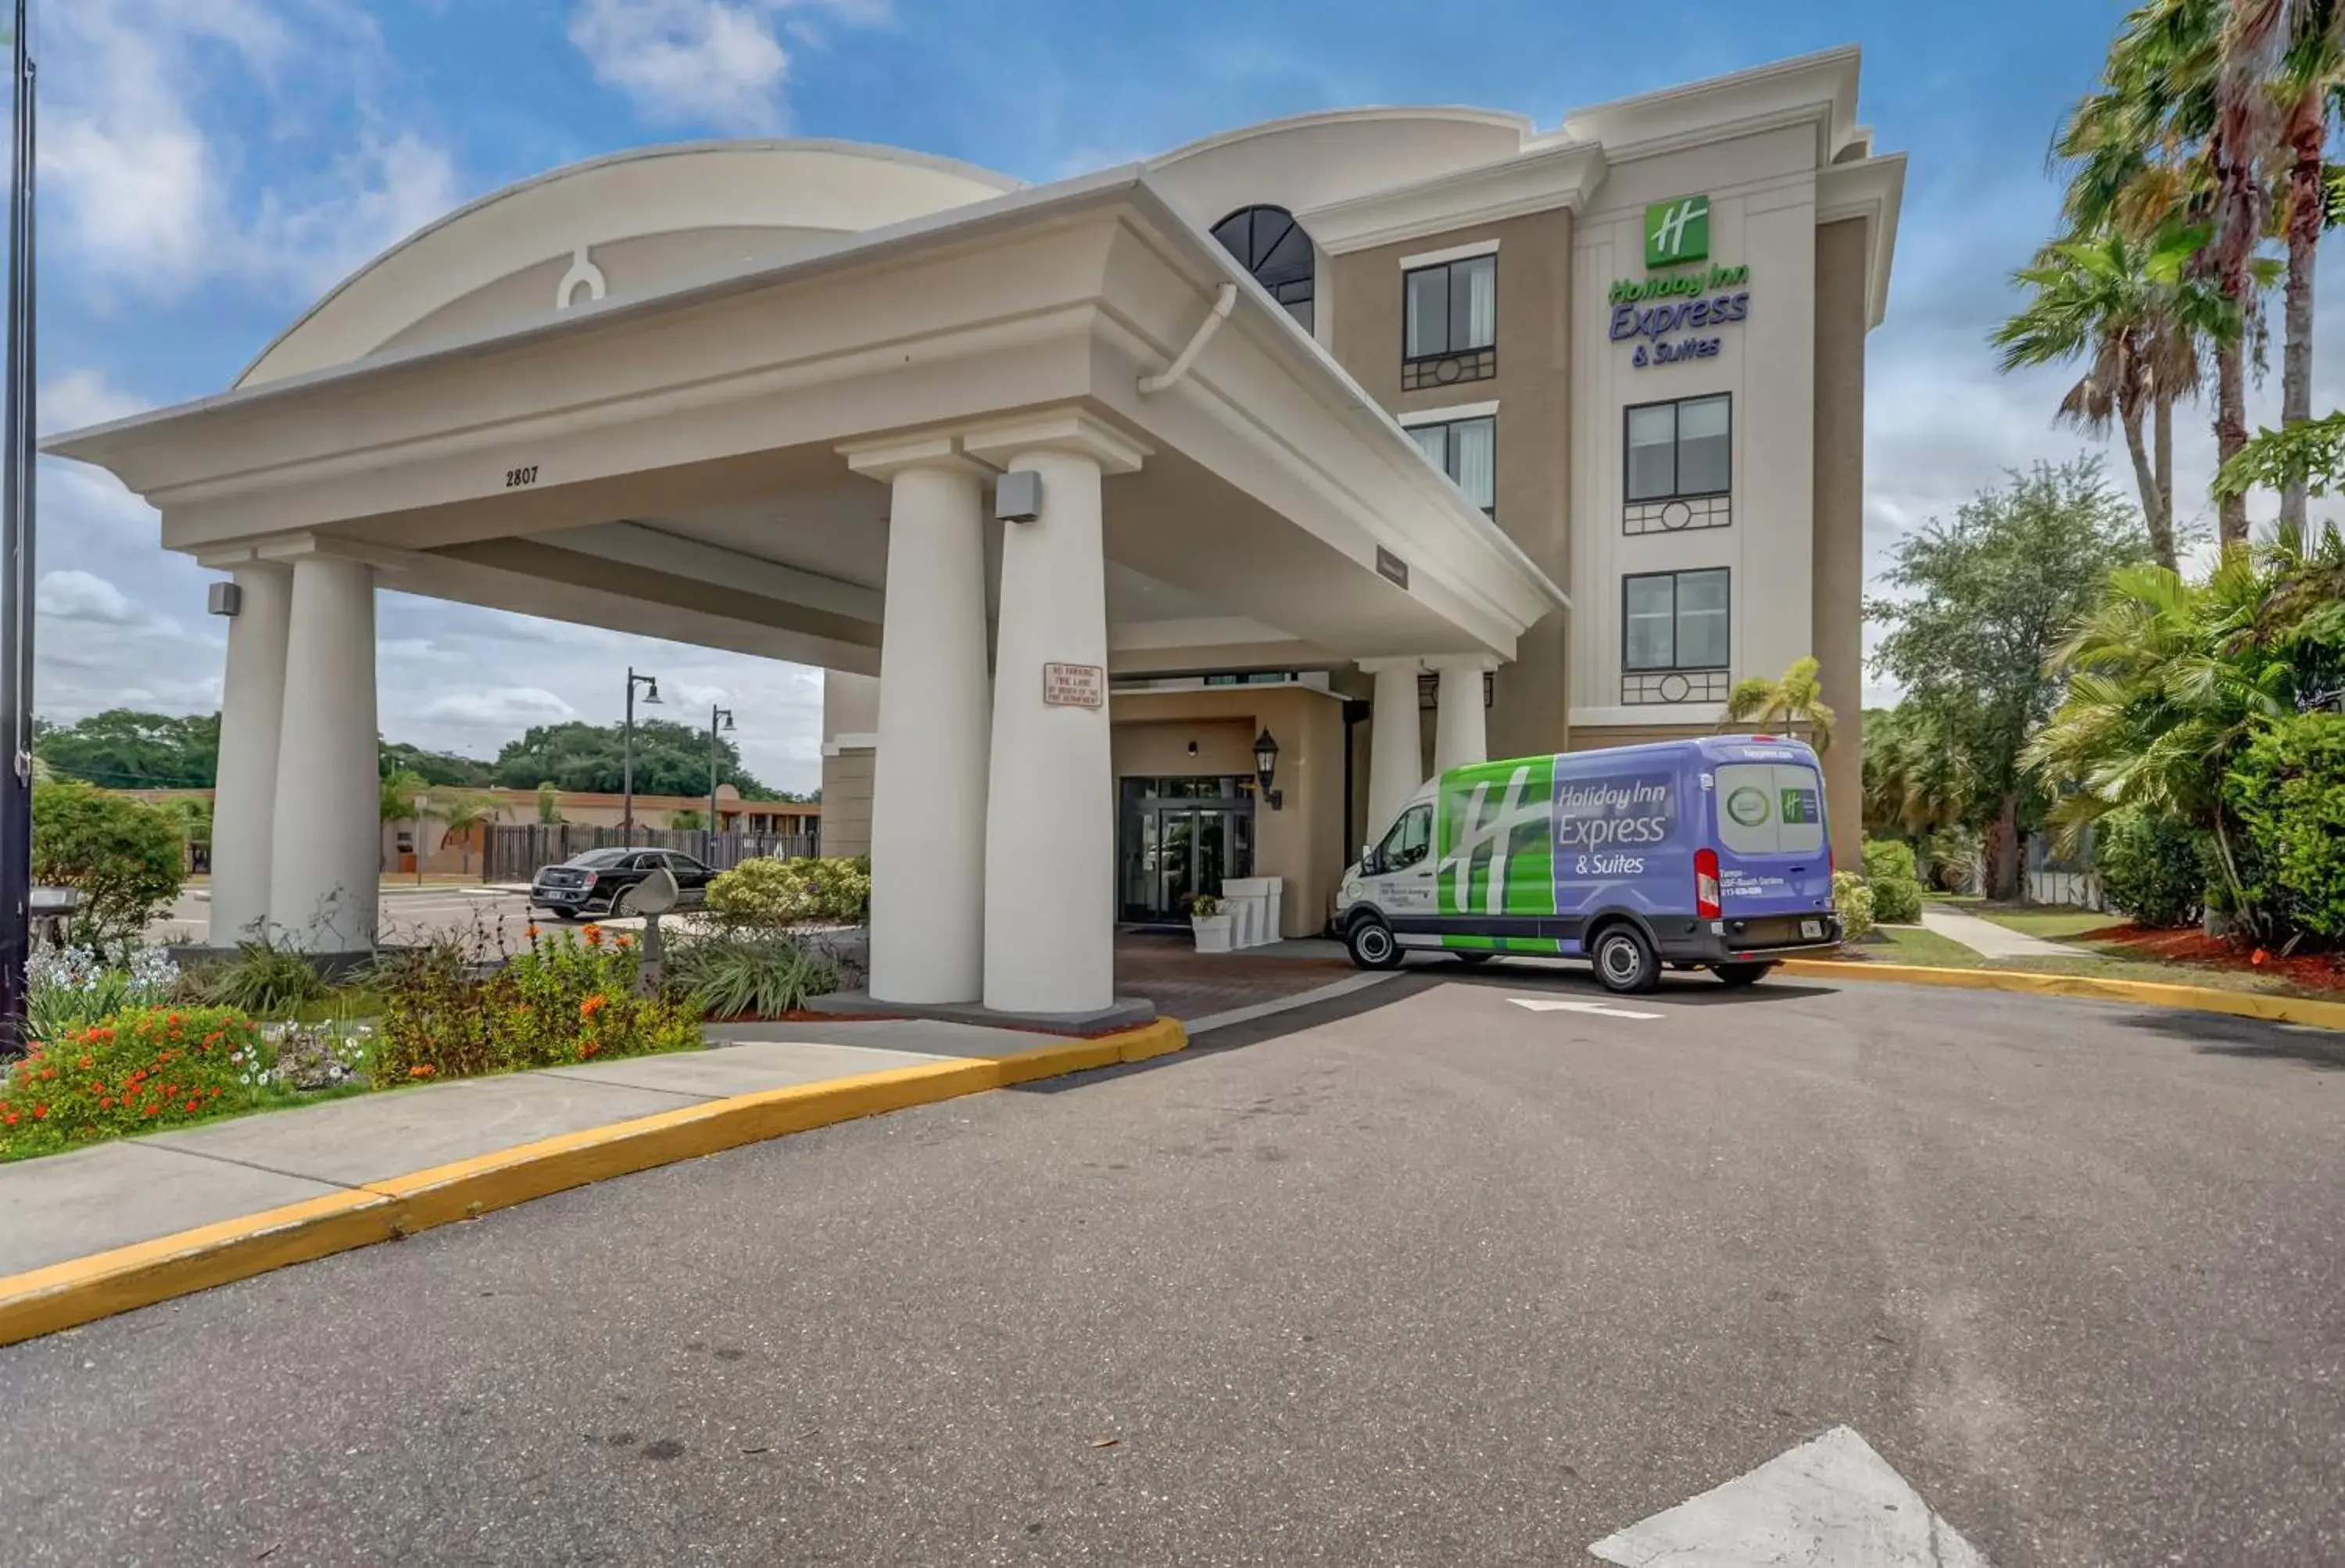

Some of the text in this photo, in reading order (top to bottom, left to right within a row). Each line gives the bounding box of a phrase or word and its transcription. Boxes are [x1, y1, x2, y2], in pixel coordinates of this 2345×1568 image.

[1609, 263, 1749, 306] Holiday Inn
[1609, 292, 1749, 342] Express
[1632, 338, 1720, 367] & Suites
[506, 465, 539, 487] 2807
[1559, 780, 1666, 810] Holiday Inn
[1559, 814, 1667, 854] Express
[1575, 854, 1645, 875] & Suites
